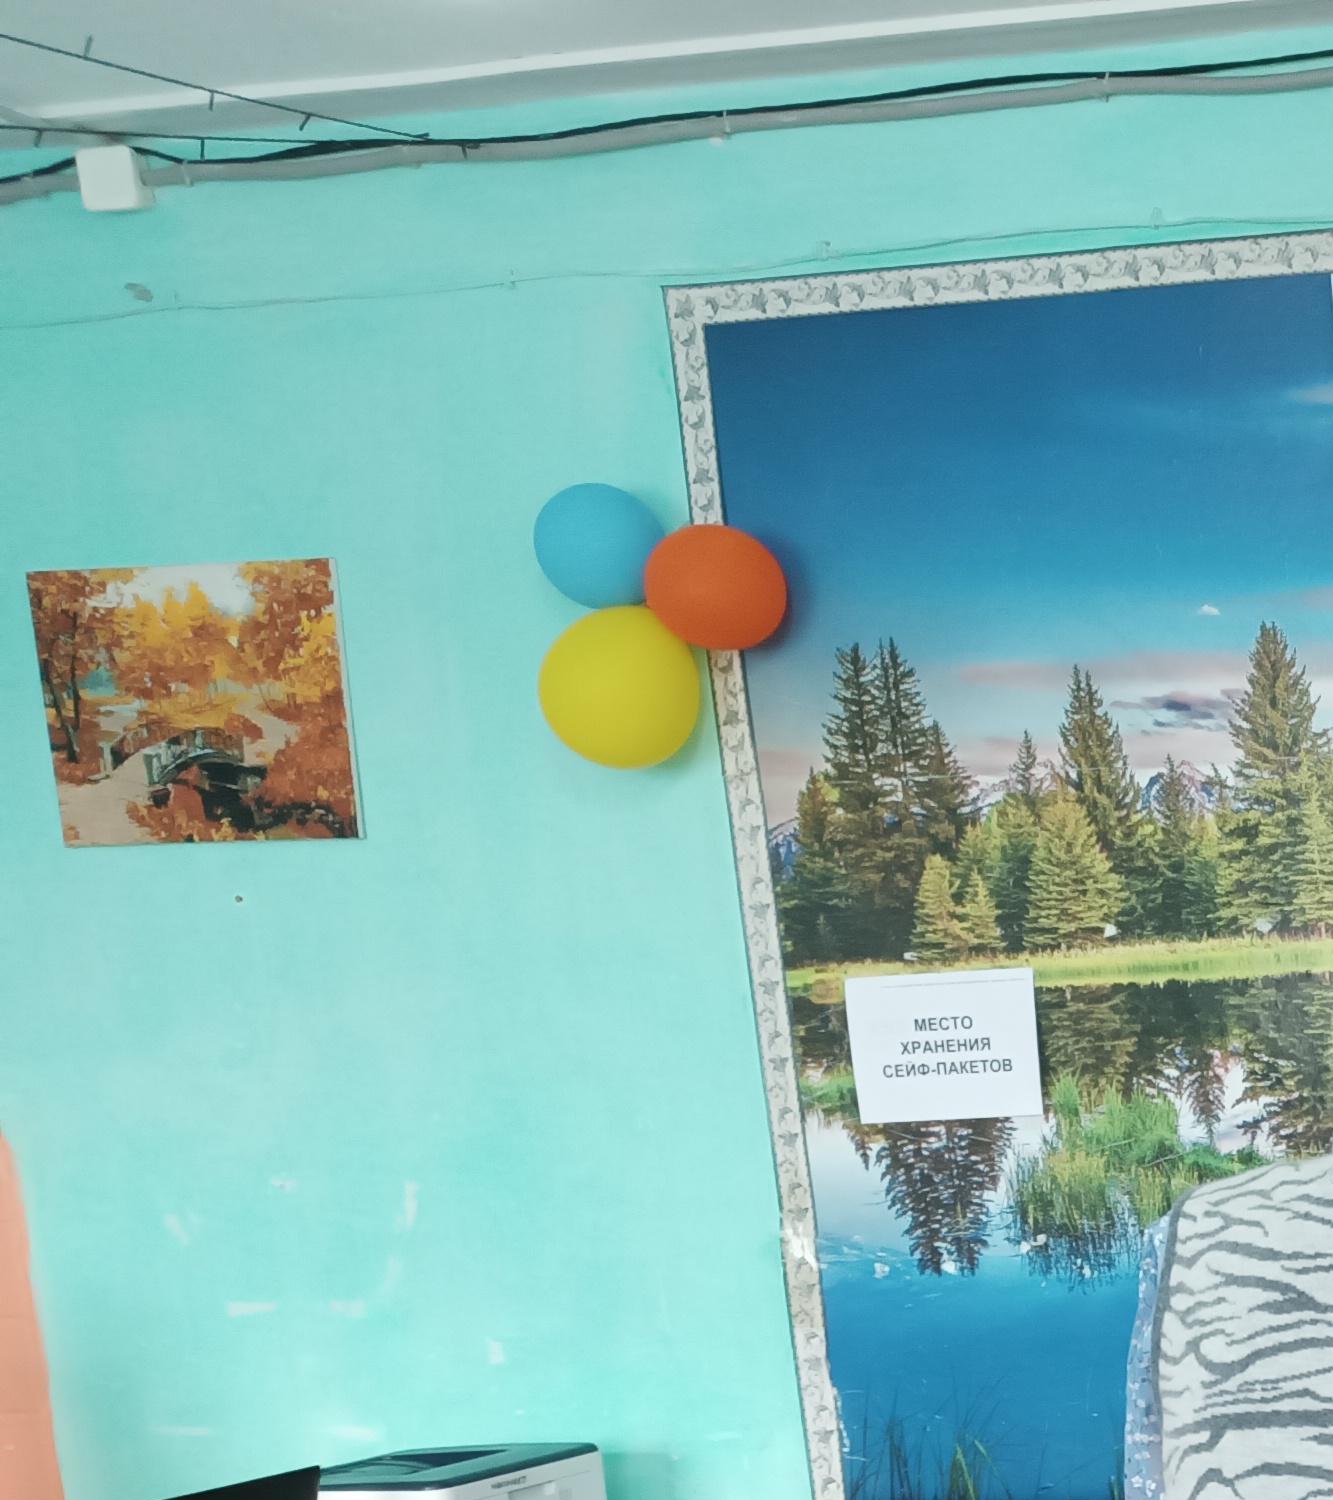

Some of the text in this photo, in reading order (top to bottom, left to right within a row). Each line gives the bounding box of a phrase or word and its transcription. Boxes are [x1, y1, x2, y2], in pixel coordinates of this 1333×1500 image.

[913, 1015, 973, 1032] МЕСТО
[900, 1037, 991, 1055] ХРАНЕНИЯ
[882, 1058, 1013, 1079] СЕЙФ-ПАКЕТОВ
